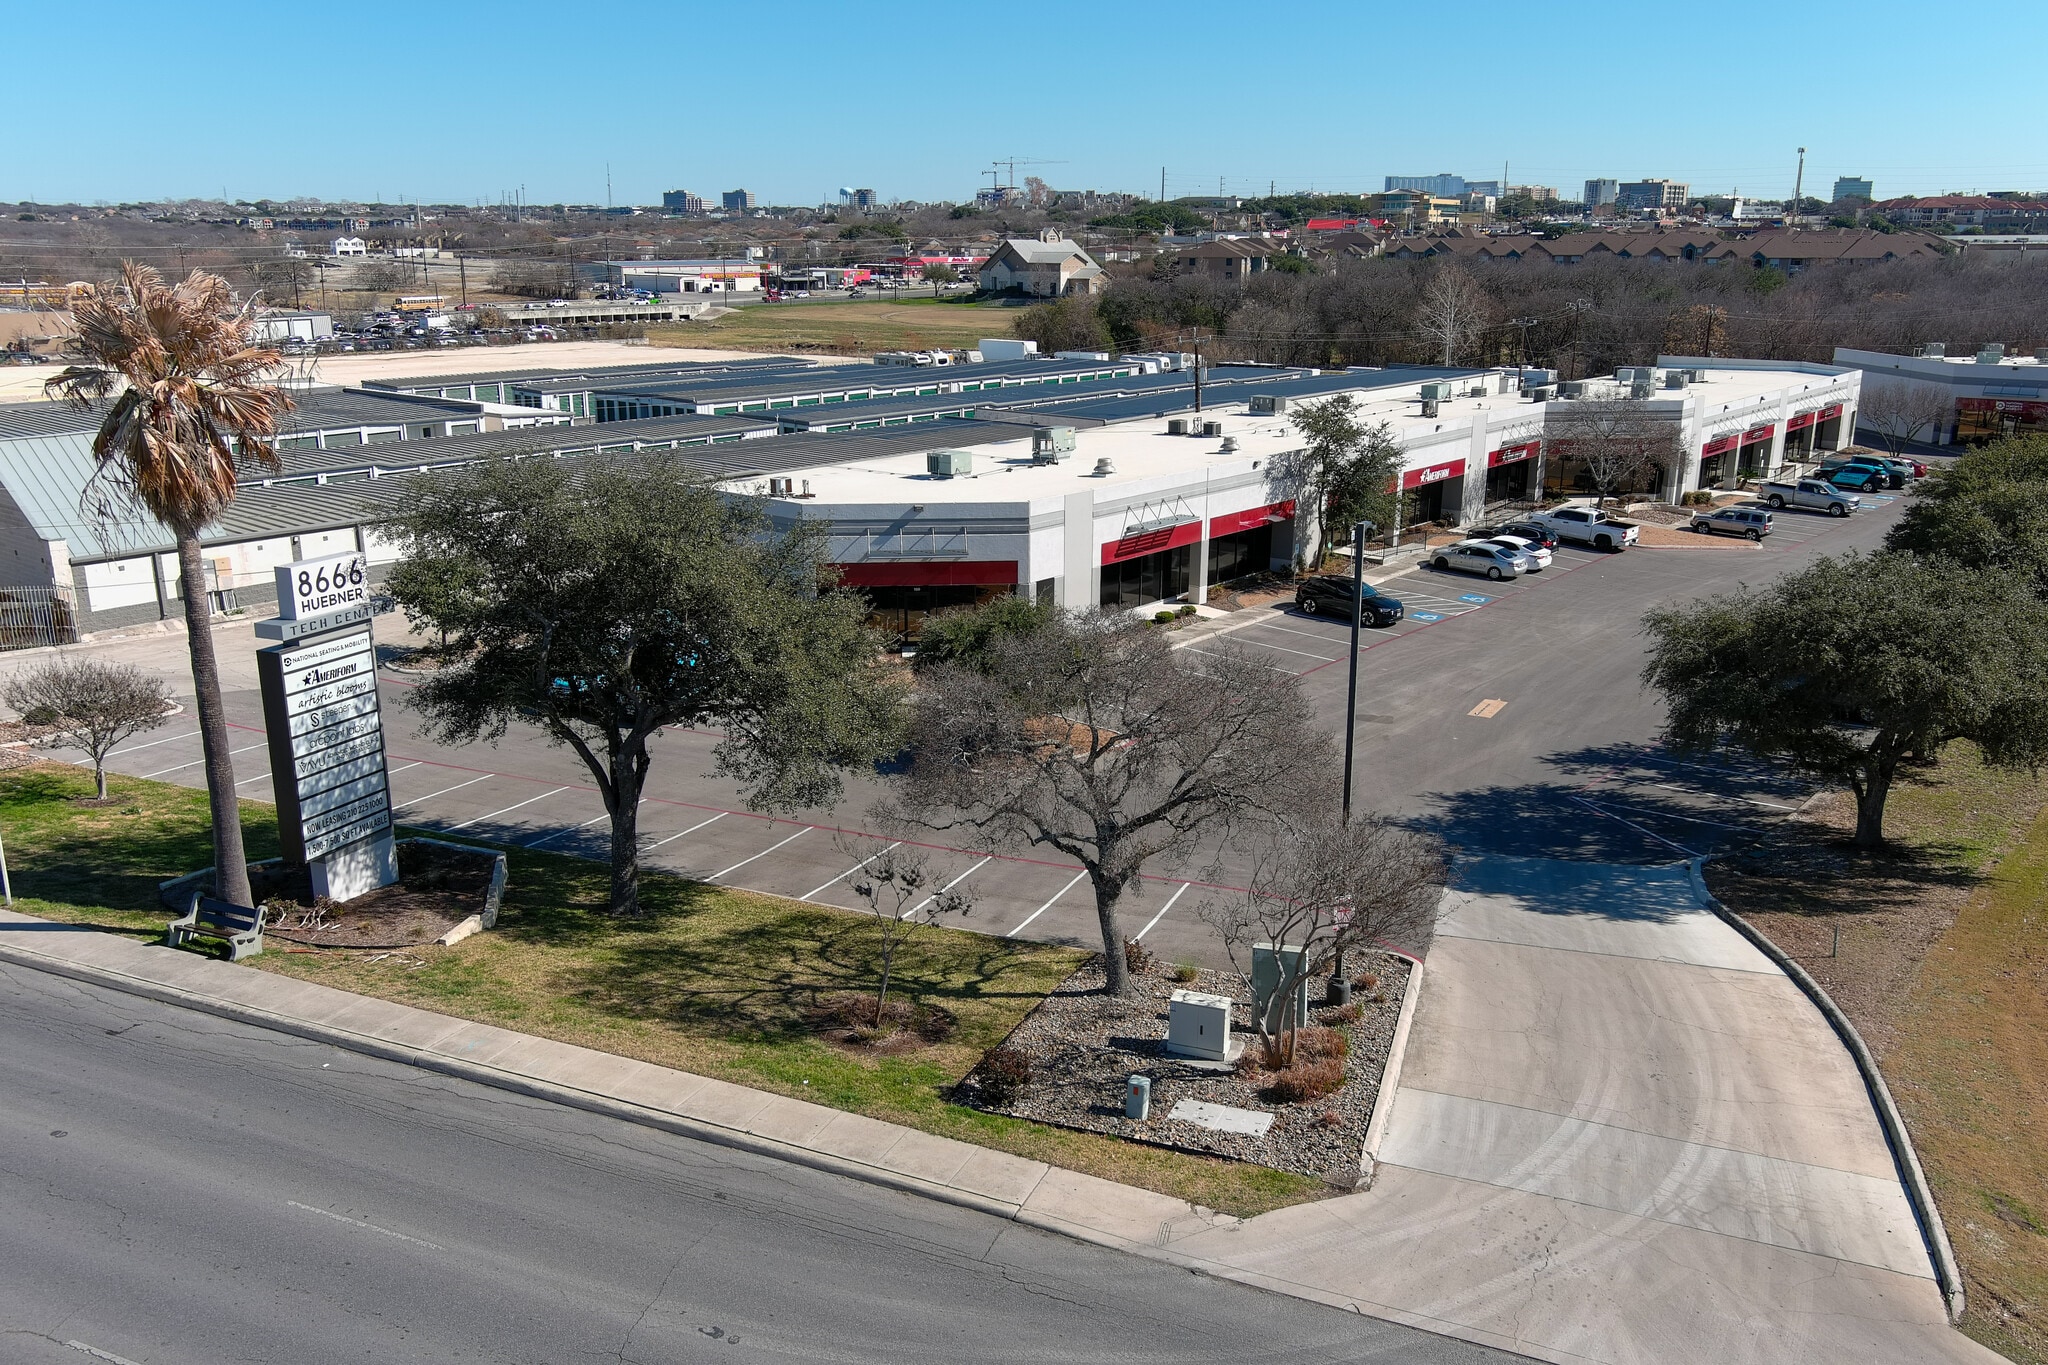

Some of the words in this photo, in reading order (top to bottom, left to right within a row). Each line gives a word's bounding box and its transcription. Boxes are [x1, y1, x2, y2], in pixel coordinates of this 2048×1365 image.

[298, 559, 363, 598] 8666
[301, 587, 364, 613] HUEBNER
[290, 618, 328, 636] TECH
[335, 604, 387, 624] CENTER
[292, 651, 319, 664] NATIONAL
[319, 645, 341, 656] SEATING
[344, 638, 369, 649] MOBILITY
[298, 690, 333, 709] artistic
[336, 680, 367, 697] blooms
[306, 821, 321, 835] NOW
[322, 812, 347, 828] LEASING
[347, 807, 358, 818] 210
[341, 830, 350, 841] SQ
[350, 828, 357, 838] FT
[358, 814, 388, 835] AVAILABLE
